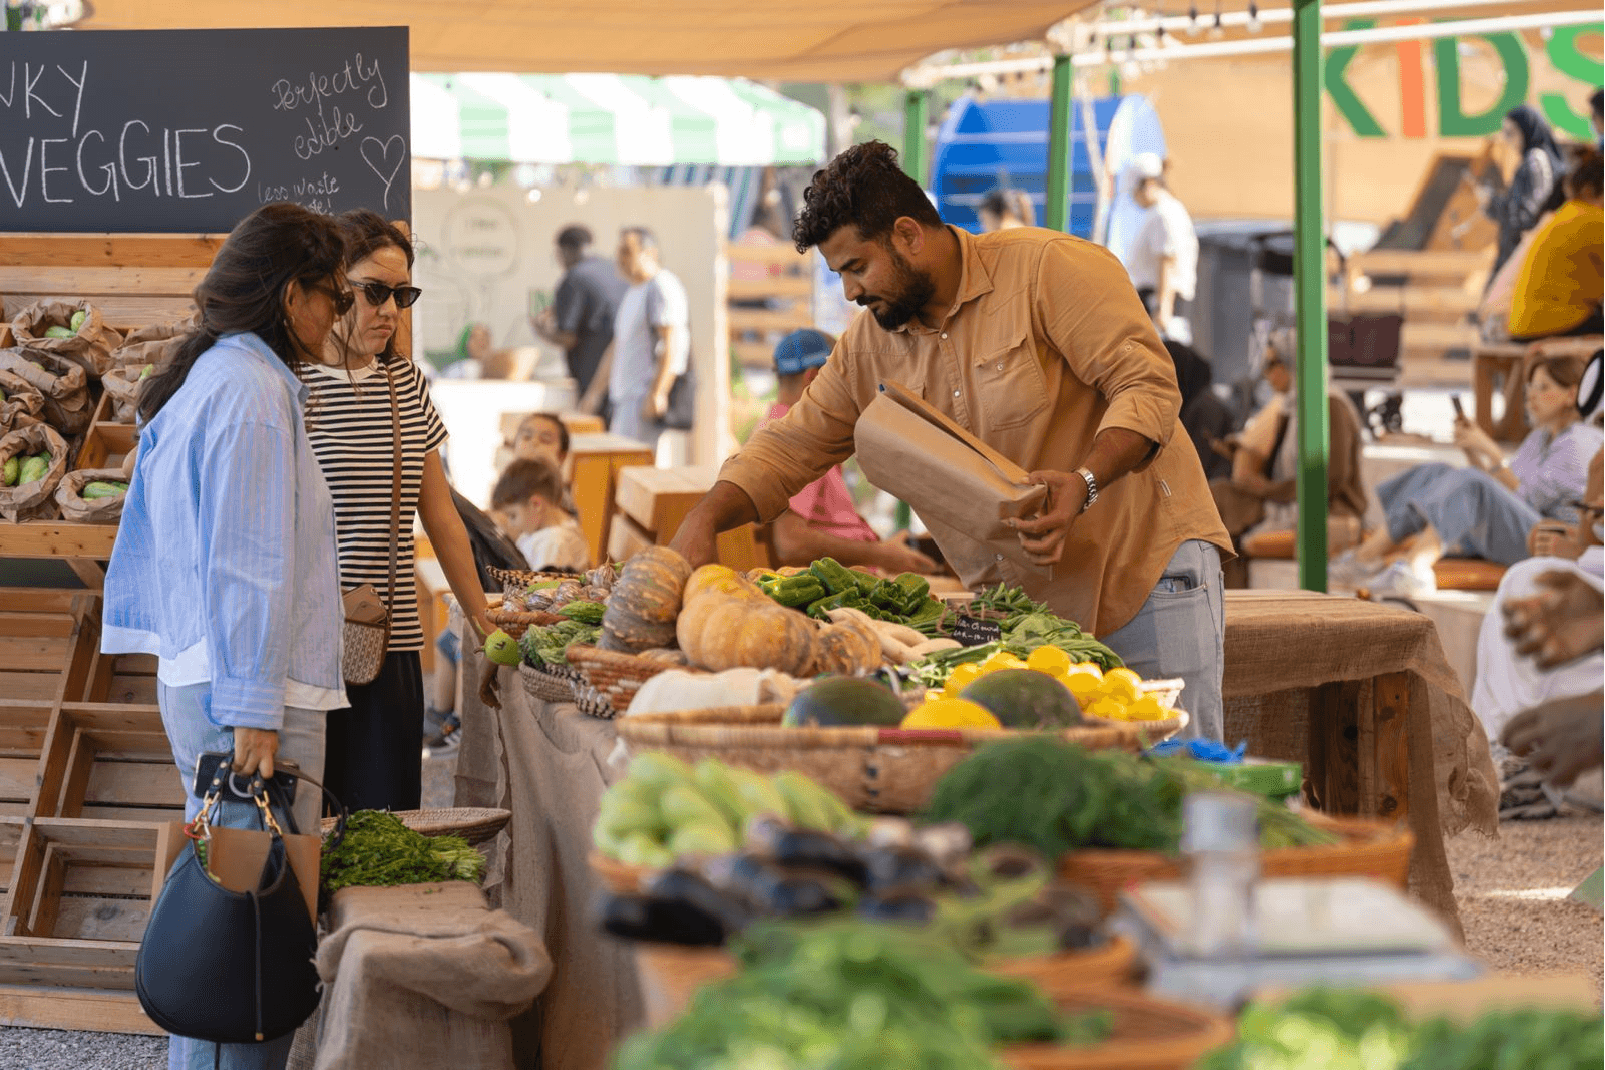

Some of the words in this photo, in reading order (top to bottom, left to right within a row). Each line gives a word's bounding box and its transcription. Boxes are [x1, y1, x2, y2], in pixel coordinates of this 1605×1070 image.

[271, 52, 388, 113] Perfectly
[0, 119, 251, 208] VEGGIES
[294, 106, 363, 160] edible
